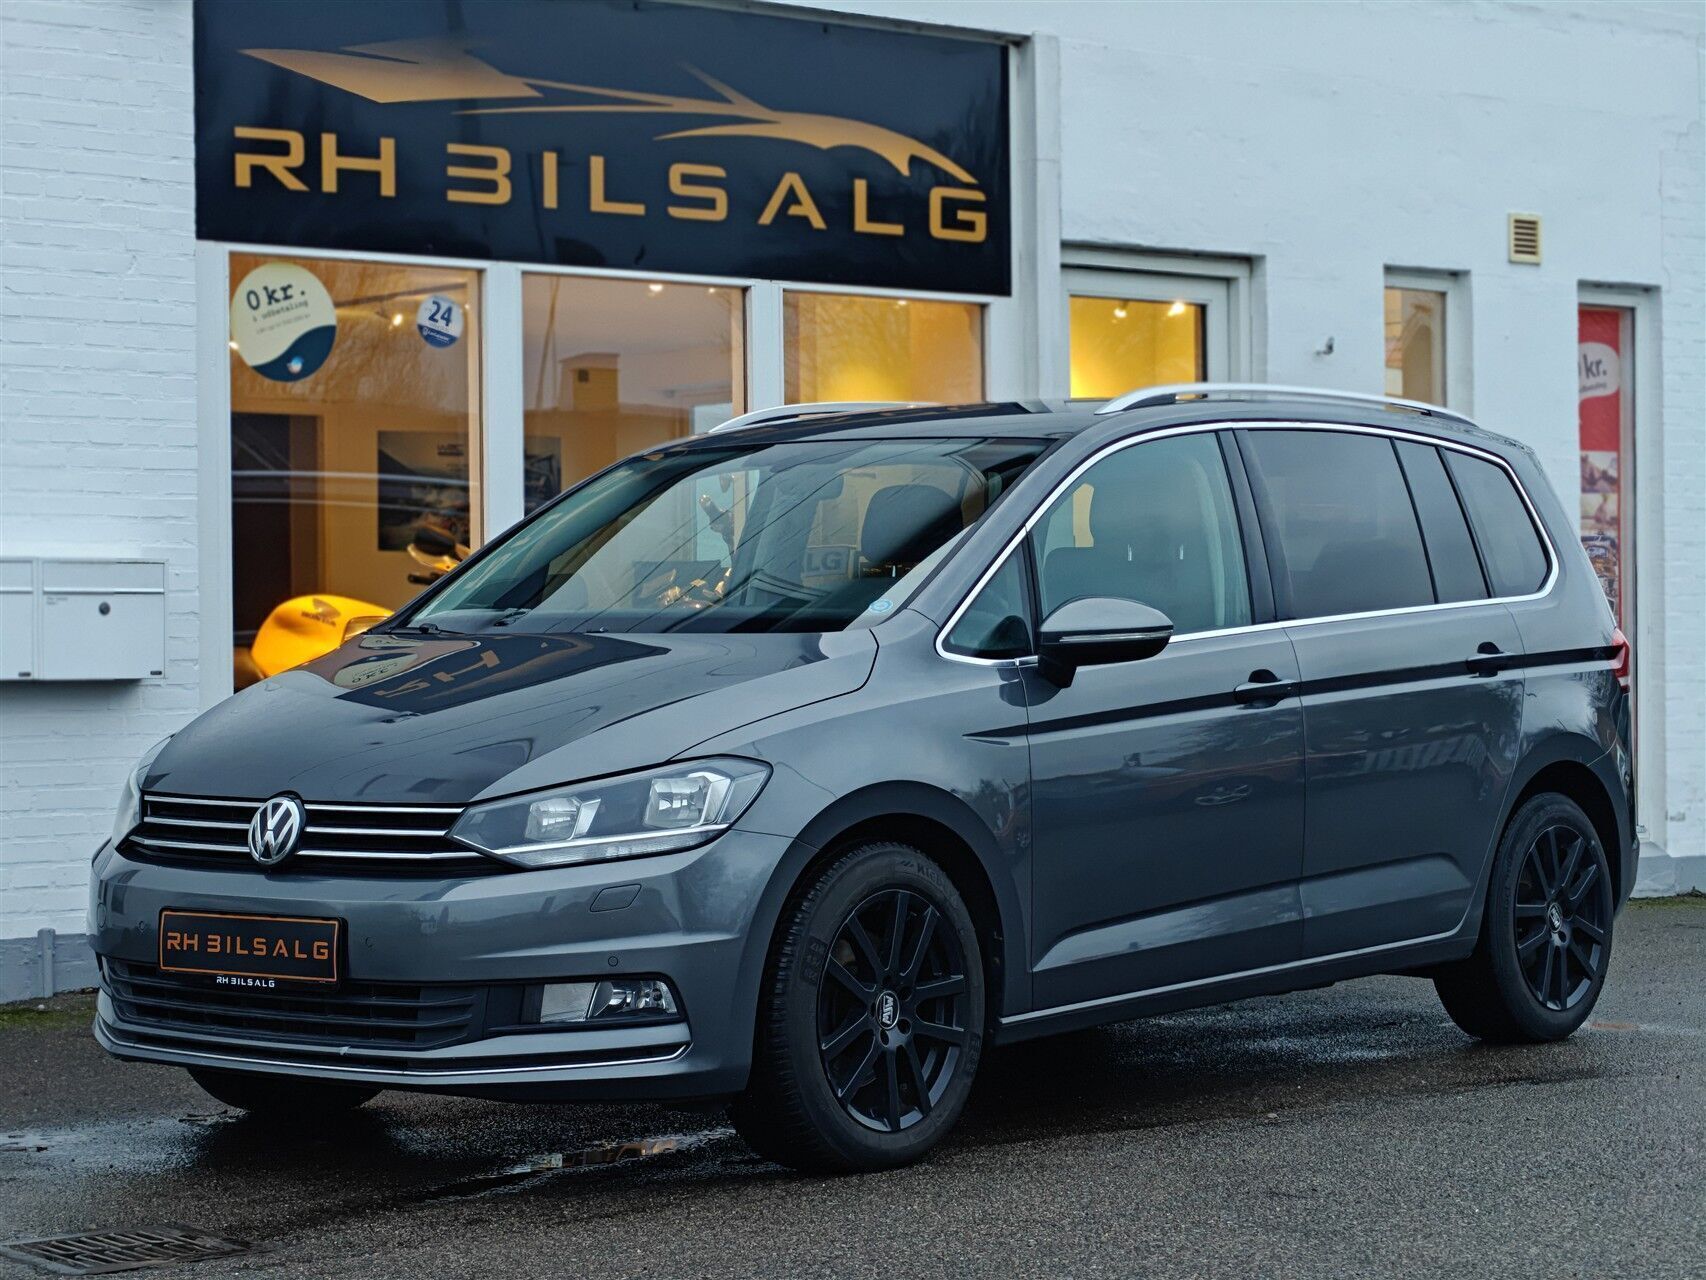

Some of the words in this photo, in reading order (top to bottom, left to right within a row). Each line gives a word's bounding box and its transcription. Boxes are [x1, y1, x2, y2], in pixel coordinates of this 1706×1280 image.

[233, 126, 396, 198] RH
[446, 142, 988, 243] BILSALG
[246, 289, 260, 311] 0
[262, 284, 305, 306] kr.
[428, 300, 453, 327] 24
[1582, 353, 1607, 380] kr.
[166, 931, 199, 952] RH
[206, 934, 330, 960] BILSALG
[216, 976, 229, 985] RH
[230, 977, 275, 988] BILSALG
